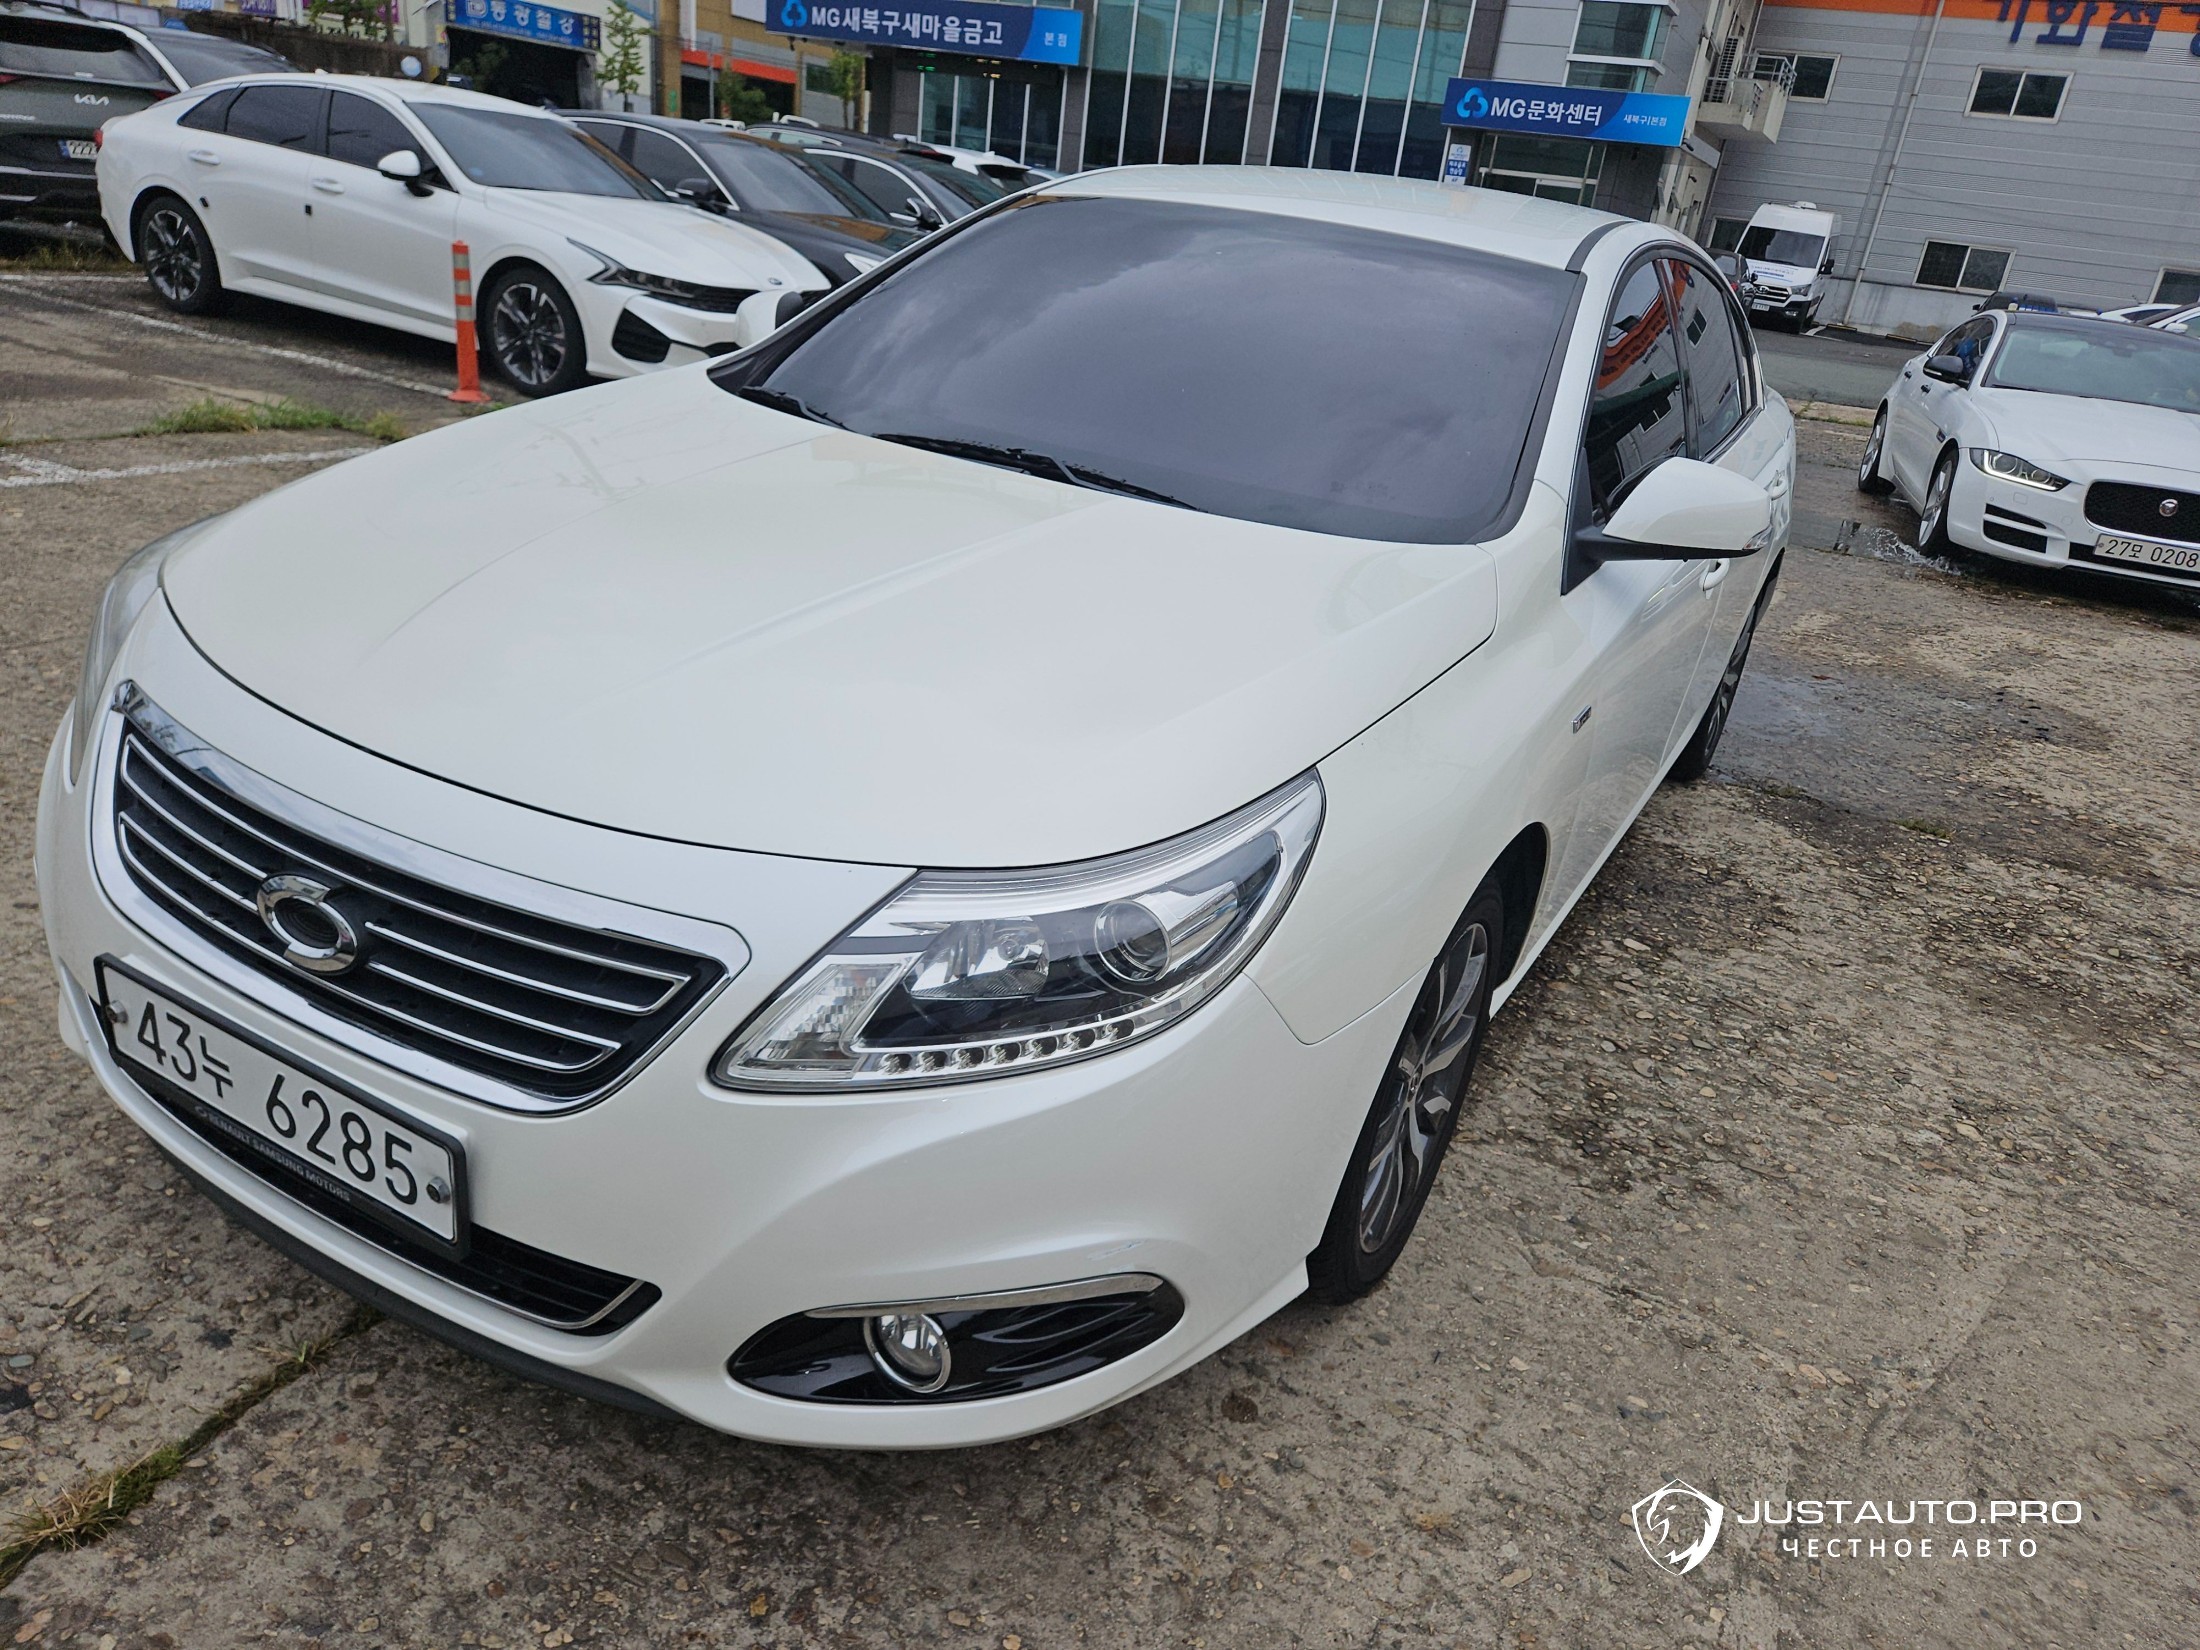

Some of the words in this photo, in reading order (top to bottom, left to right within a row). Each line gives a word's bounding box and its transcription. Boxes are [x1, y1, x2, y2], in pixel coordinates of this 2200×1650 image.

[1490, 97, 1602, 126] MG문화센터
[2105, 539, 2143, 558] 27모
[2150, 547, 2200, 568] 0208
[137, 1001, 233, 1099] 43누
[265, 1074, 418, 1205] 6285
[207, 1113, 251, 1145] RENAULT
[251, 1138, 304, 1177] SAMSUNG
[305, 1170, 351, 1201] MOTORS
